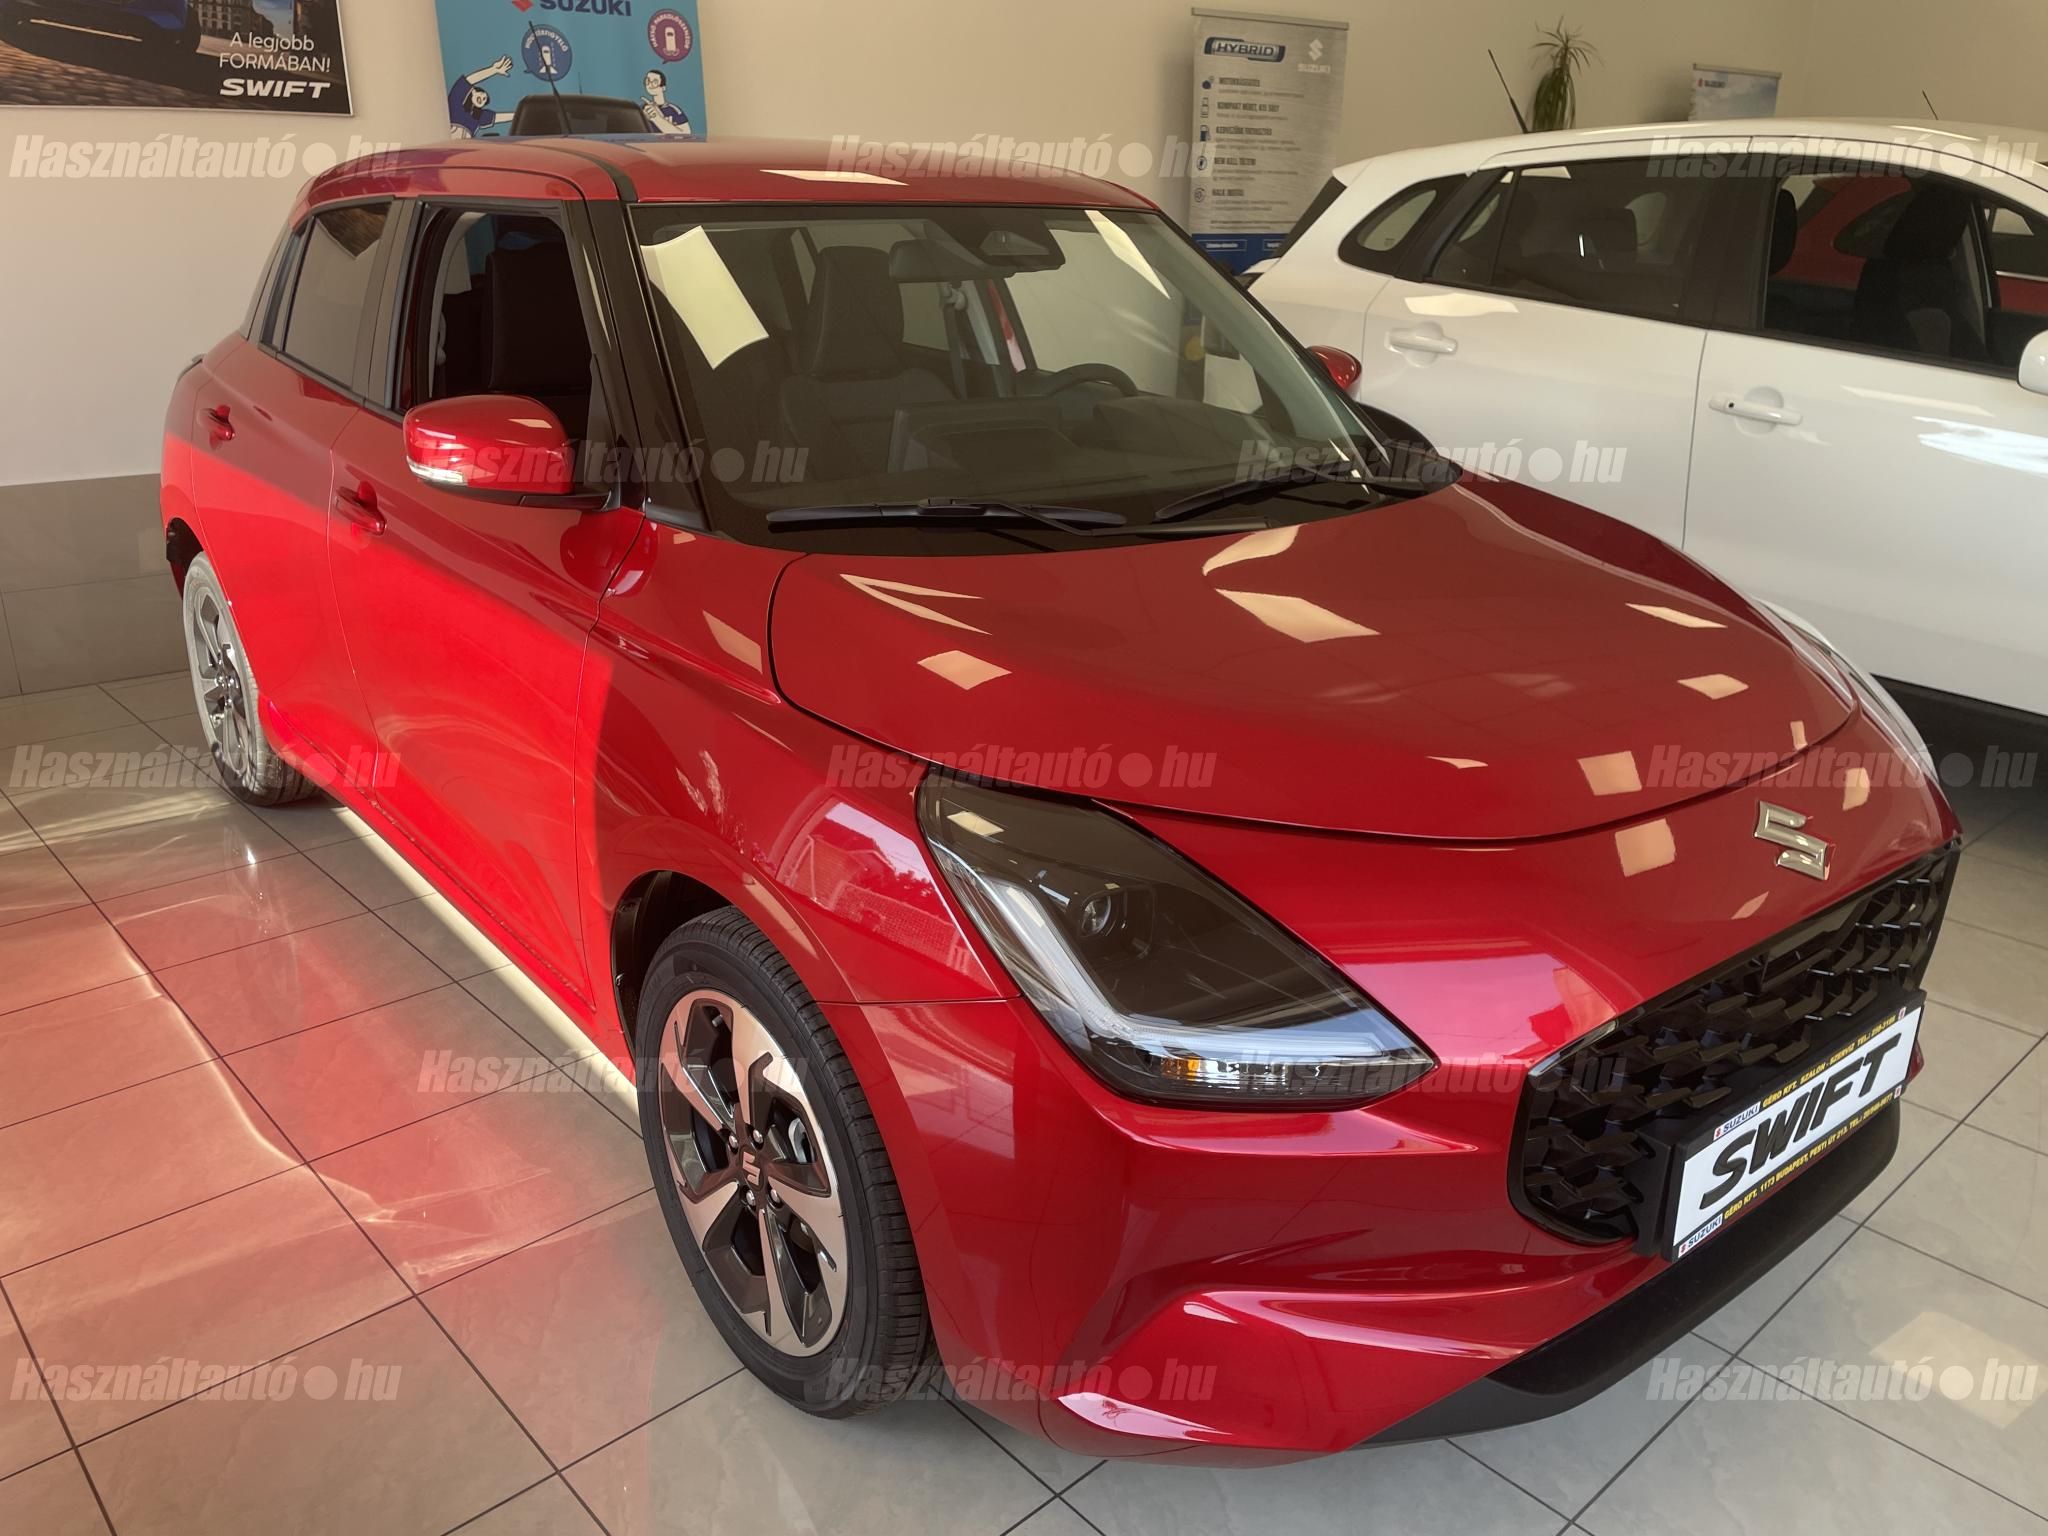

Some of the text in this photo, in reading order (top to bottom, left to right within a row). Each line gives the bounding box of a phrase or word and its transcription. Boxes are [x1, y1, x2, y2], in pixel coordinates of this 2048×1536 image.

[230, 31, 315, 53] A legjobb
[1215, 42, 1274, 57] HYBRID
[219, 52, 331, 73] FORMÁBAN!
[220, 78, 331, 99] SWIFT
[1723, 1104, 1758, 1132] SUZUKI
[1800, 1062, 1826, 1084] SZALON
[1700, 1032, 1902, 1211] SWIFT
[1688, 1216, 1721, 1248] SUZUKI
[1760, 1176, 1775, 1192] 1173
